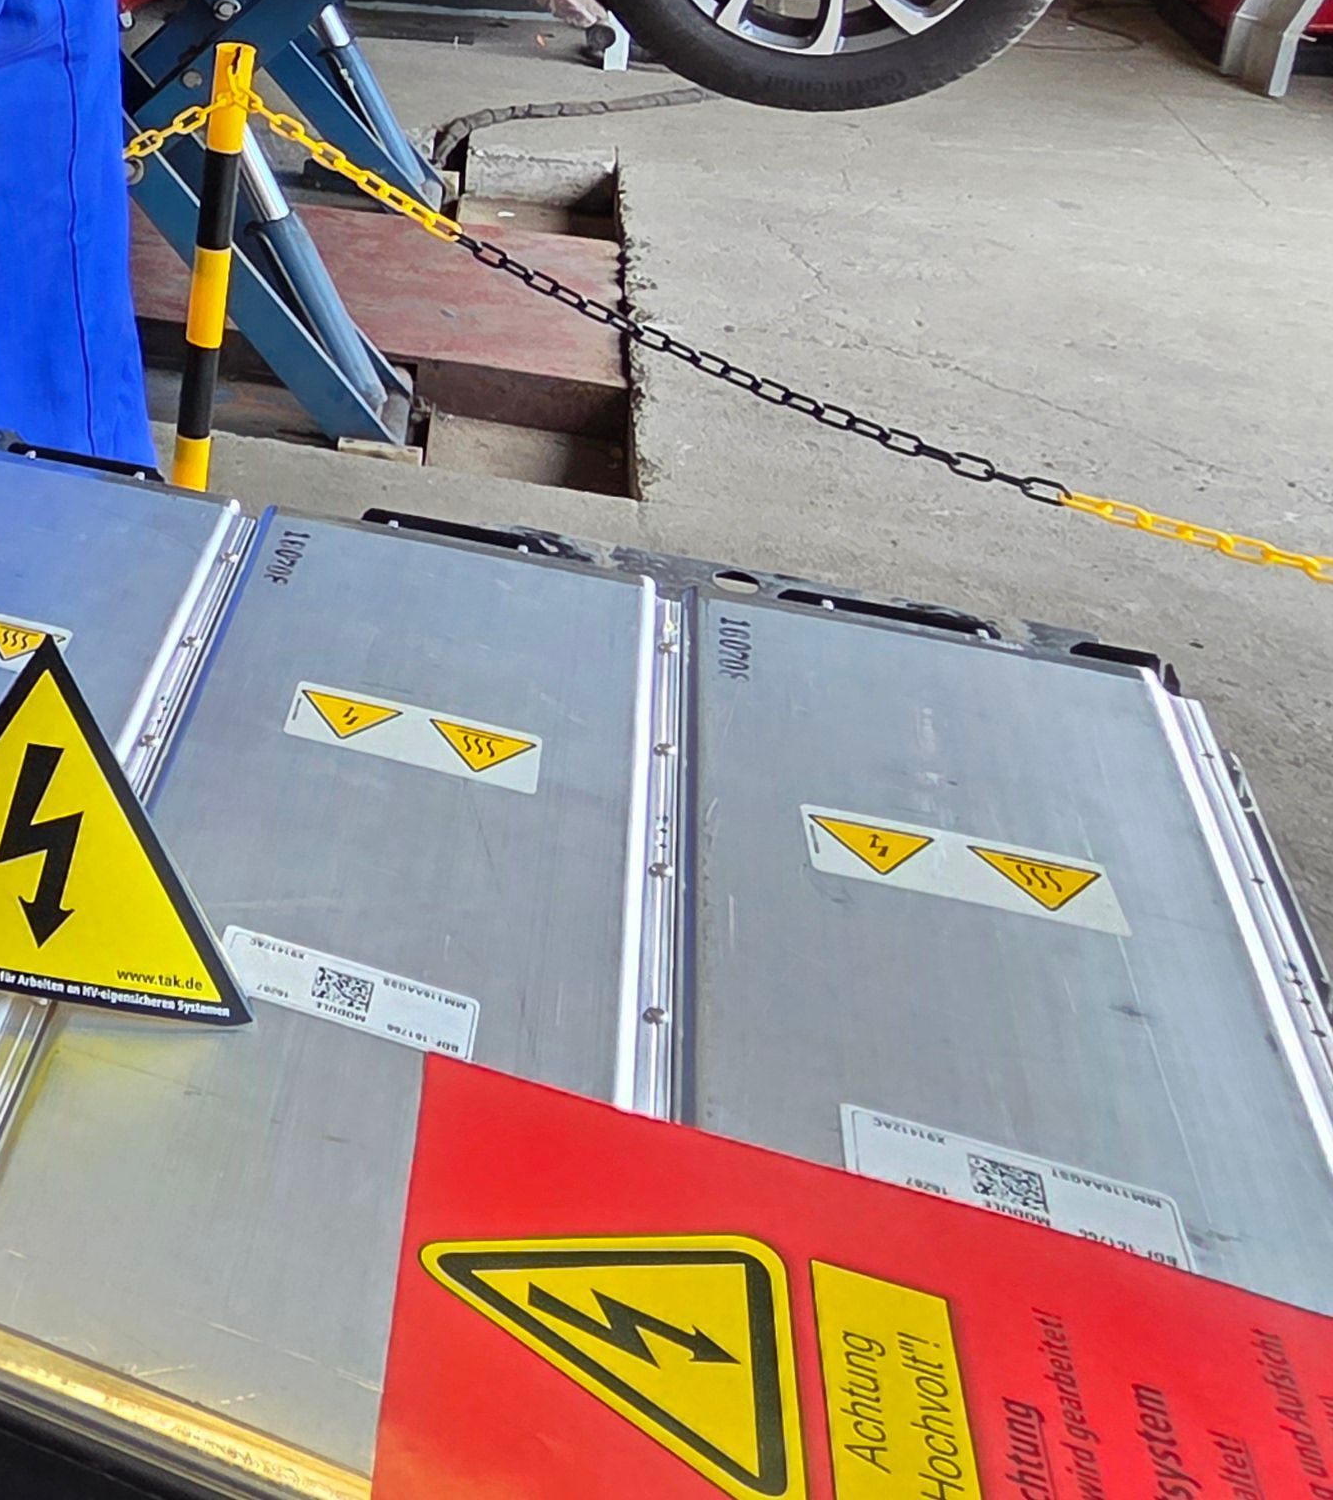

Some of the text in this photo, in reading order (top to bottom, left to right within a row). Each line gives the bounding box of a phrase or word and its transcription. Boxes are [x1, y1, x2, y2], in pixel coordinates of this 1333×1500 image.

[0, 968, 16, 984] für
[17, 973, 65, 994] Arbeiten
[67, 984, 81, 996] an
[82, 985, 176, 1010] HV-eigensicheren
[178, 998, 231, 1018] Systemen
[116, 967, 204, 992] www.tak.de
[315, 1001, 367, 1023] MODULE
[843, 1329, 892, 1474] Achtung
[1031, 1306, 1107, 1500] wird gearbeitet!
[1250, 1328, 1313, 1429] Aufsicht
[1001, 1396, 1051, 1500] chtung
[1130, 1383, 1203, 1500] system
[1206, 1428, 1259, 1500] altet!
[1278, 1424, 1329, 1479] und
